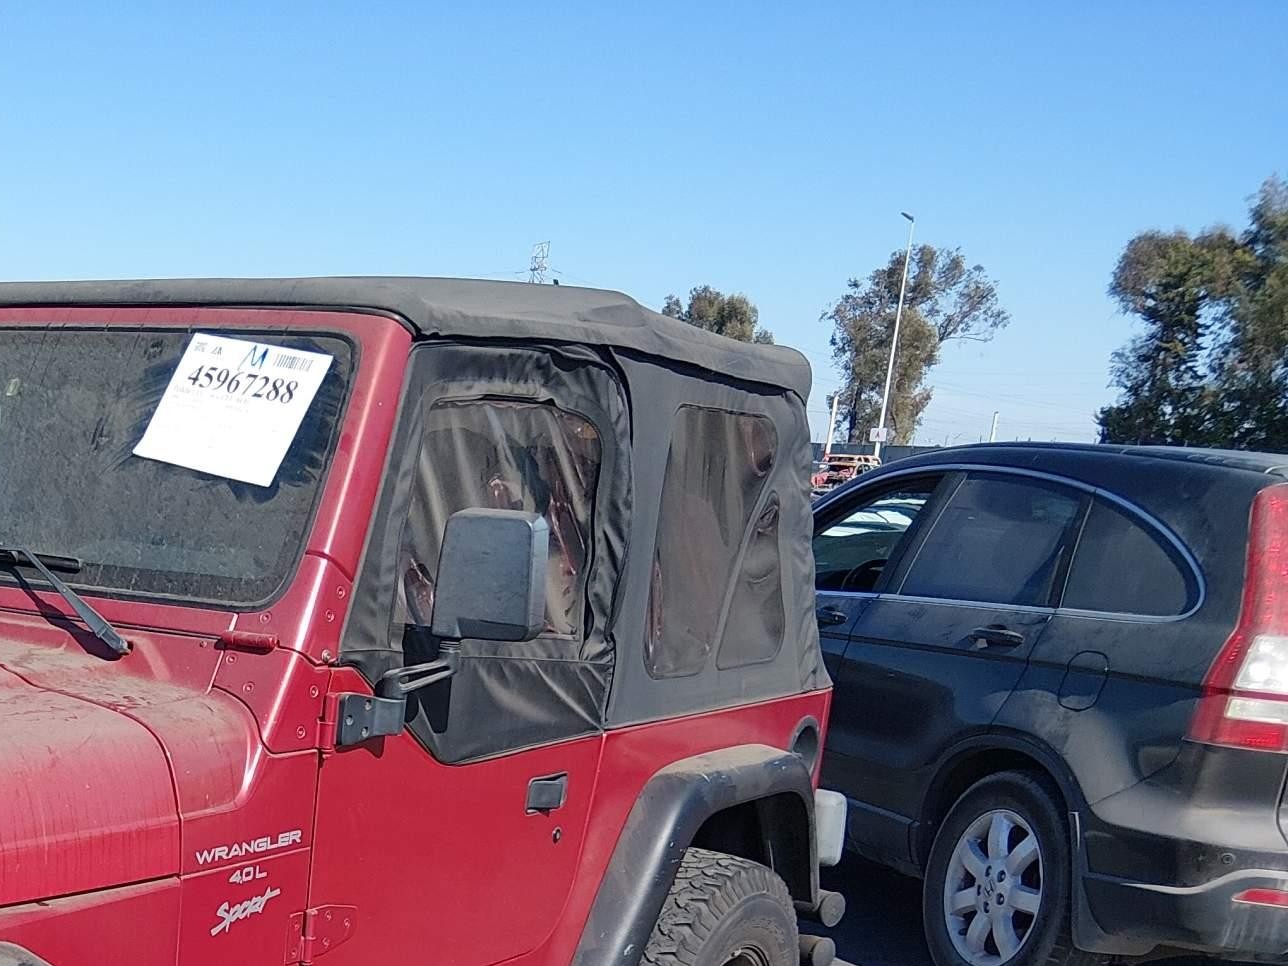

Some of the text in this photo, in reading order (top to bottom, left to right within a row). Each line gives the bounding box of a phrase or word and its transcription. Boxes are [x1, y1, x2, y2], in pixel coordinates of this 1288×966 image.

[187, 364, 299, 405] 45967288
[195, 829, 302, 865] WRANGLER
[210, 886, 281, 937] Sport
